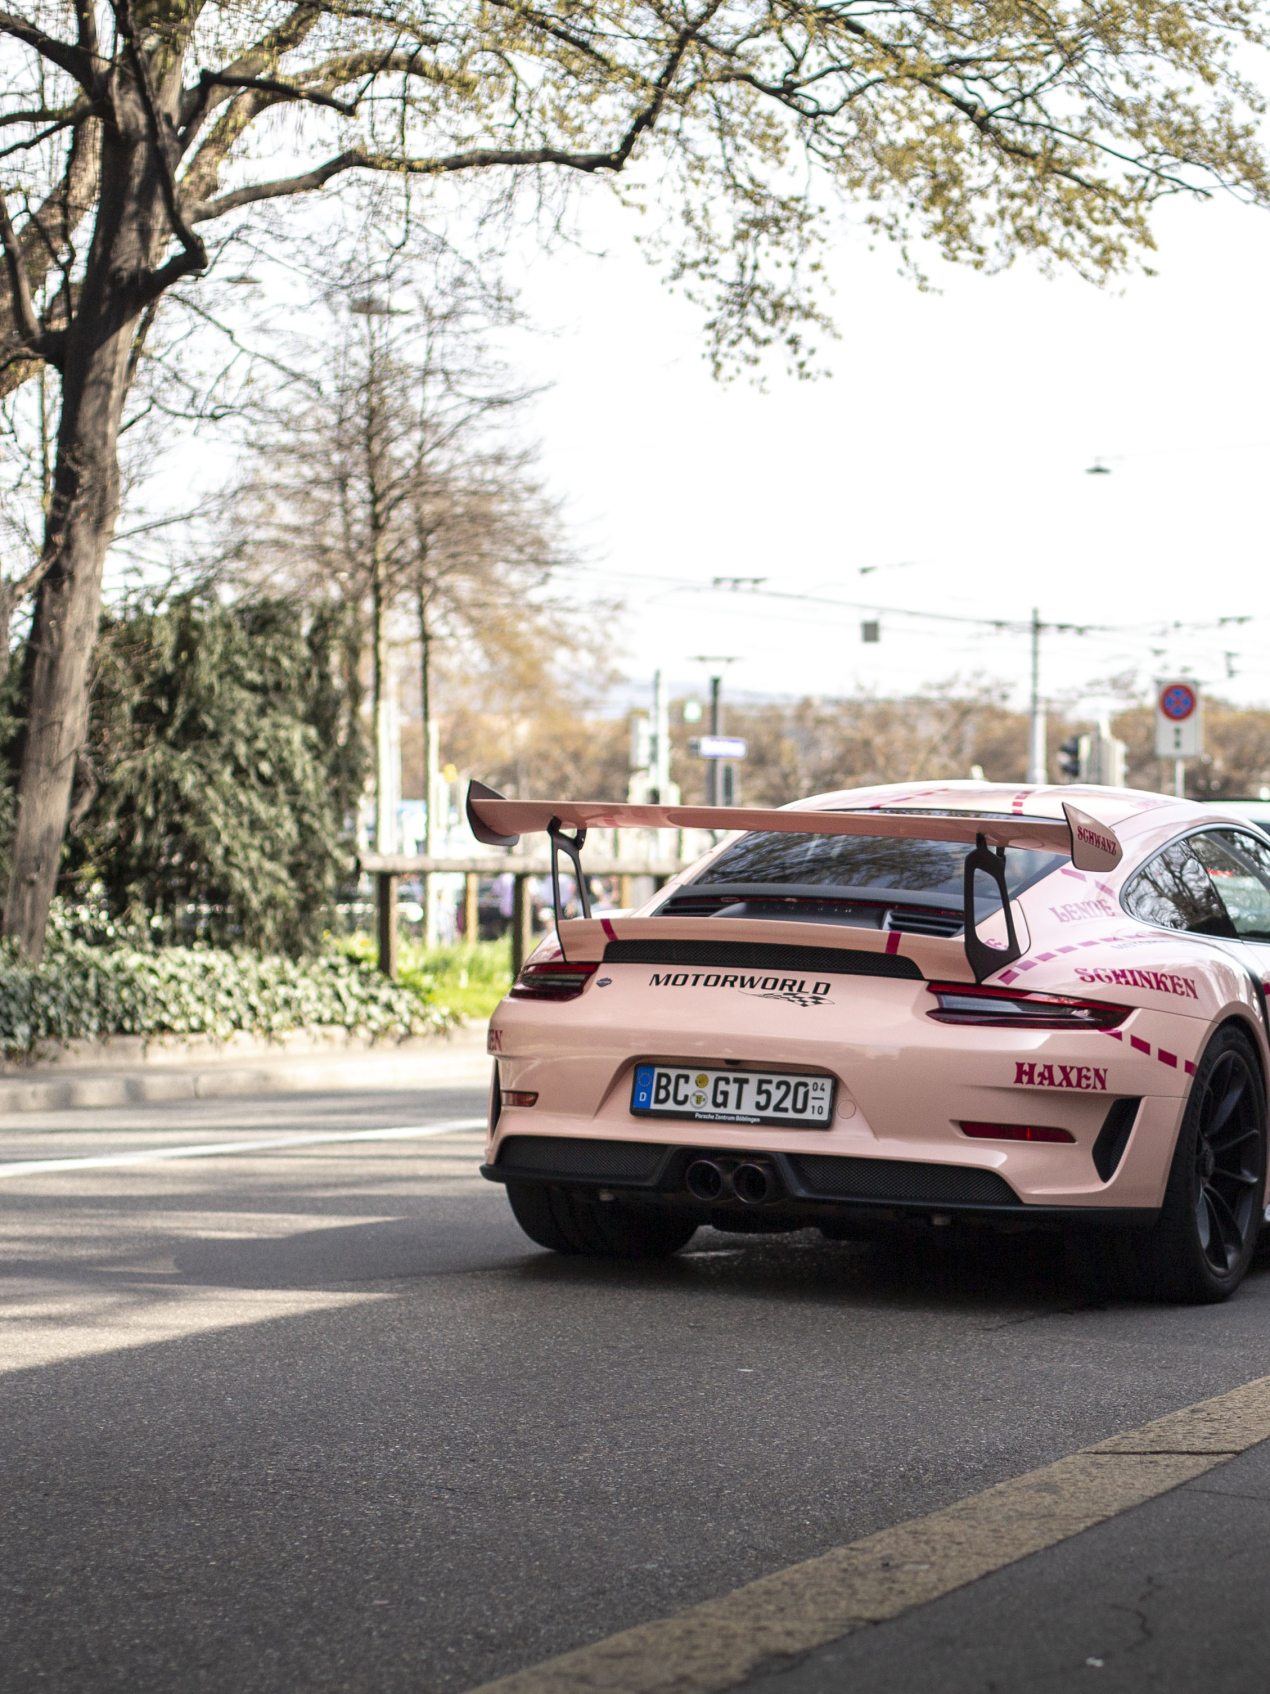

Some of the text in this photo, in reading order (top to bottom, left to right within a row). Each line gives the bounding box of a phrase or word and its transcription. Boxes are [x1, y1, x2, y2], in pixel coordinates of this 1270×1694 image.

[1077, 825, 1117, 856] SCHWANZ
[1049, 898, 1116, 923] LENDE
[649, 973, 832, 996] MOTORWORLD
[1074, 967, 1199, 1000] SCHINKEN
[812, 1081, 826, 1093] 04
[1013, 1061, 1109, 1091] HAXEN
[639, 1091, 648, 1102] D
[653, 1072, 810, 1114] BC GT 520
[811, 1104, 824, 1116] 10
